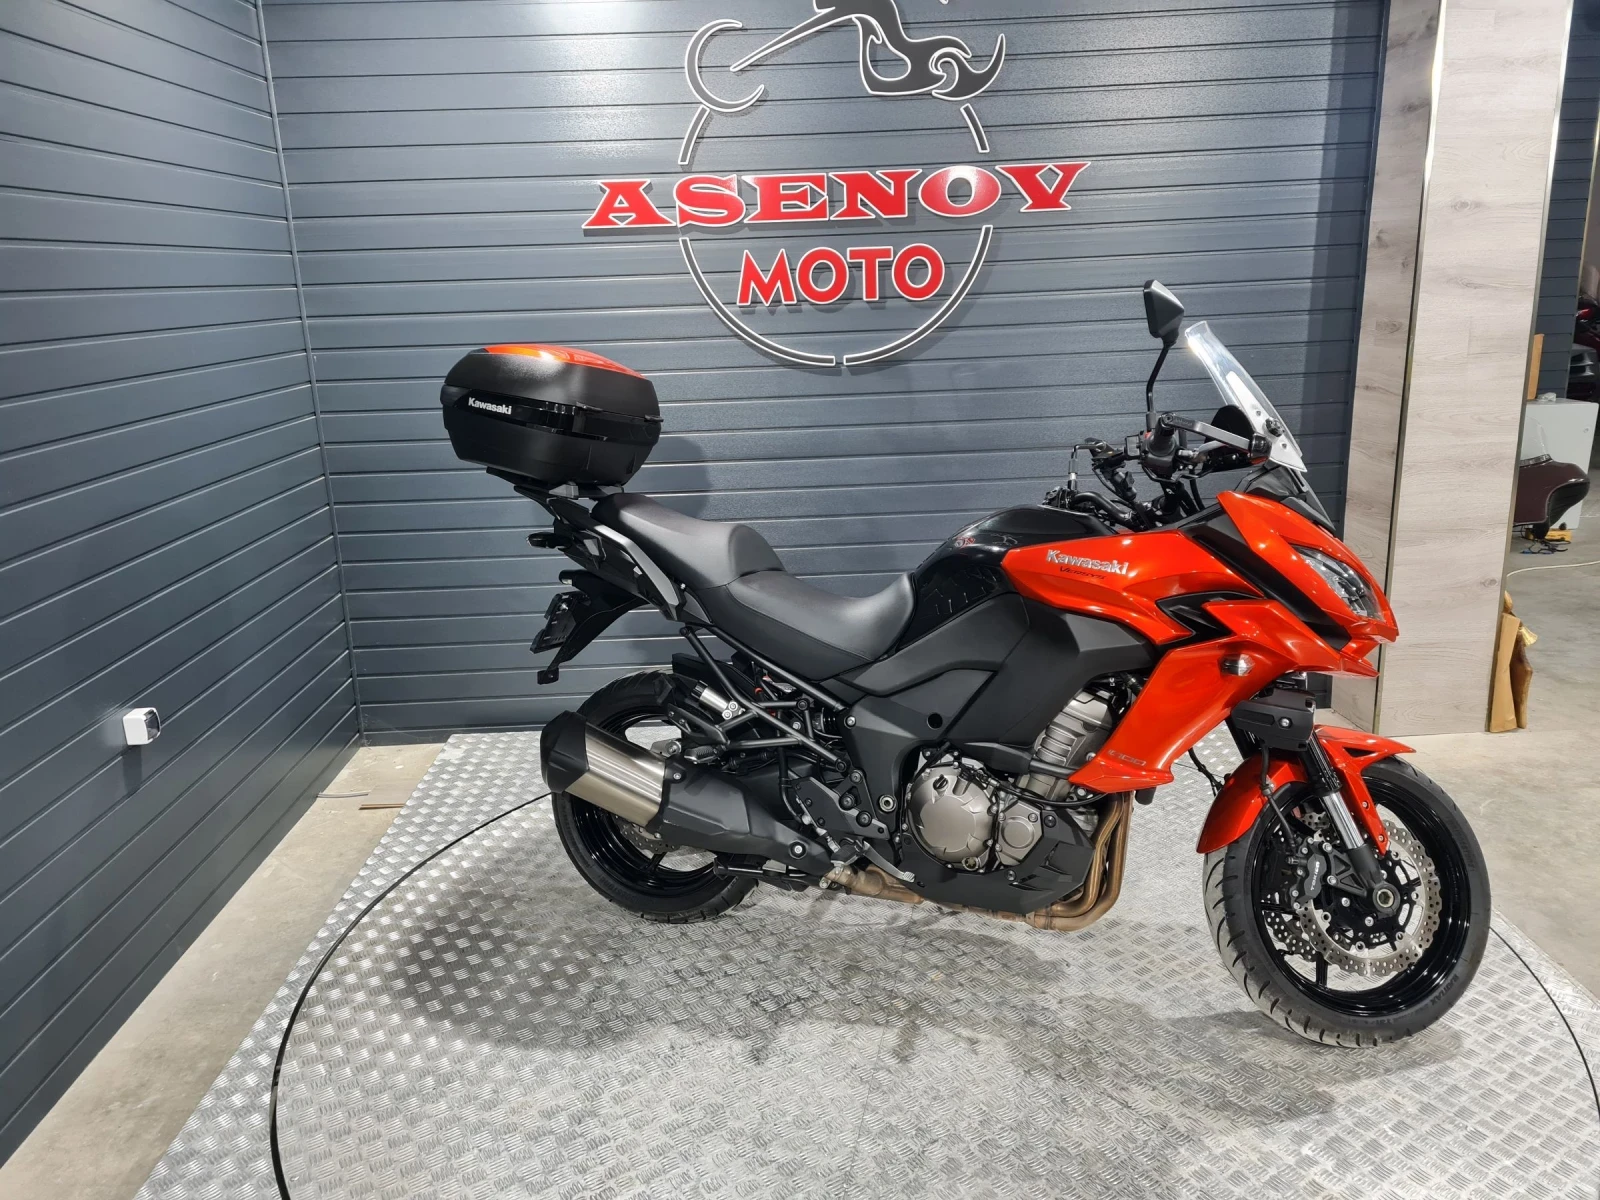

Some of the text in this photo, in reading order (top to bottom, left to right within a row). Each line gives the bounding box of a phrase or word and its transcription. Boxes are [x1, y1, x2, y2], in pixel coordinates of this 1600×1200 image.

[736, 243, 946, 307] MOTO
[468, 397, 513, 415] Kawasaki
[1046, 549, 1129, 575] Kawasaki
